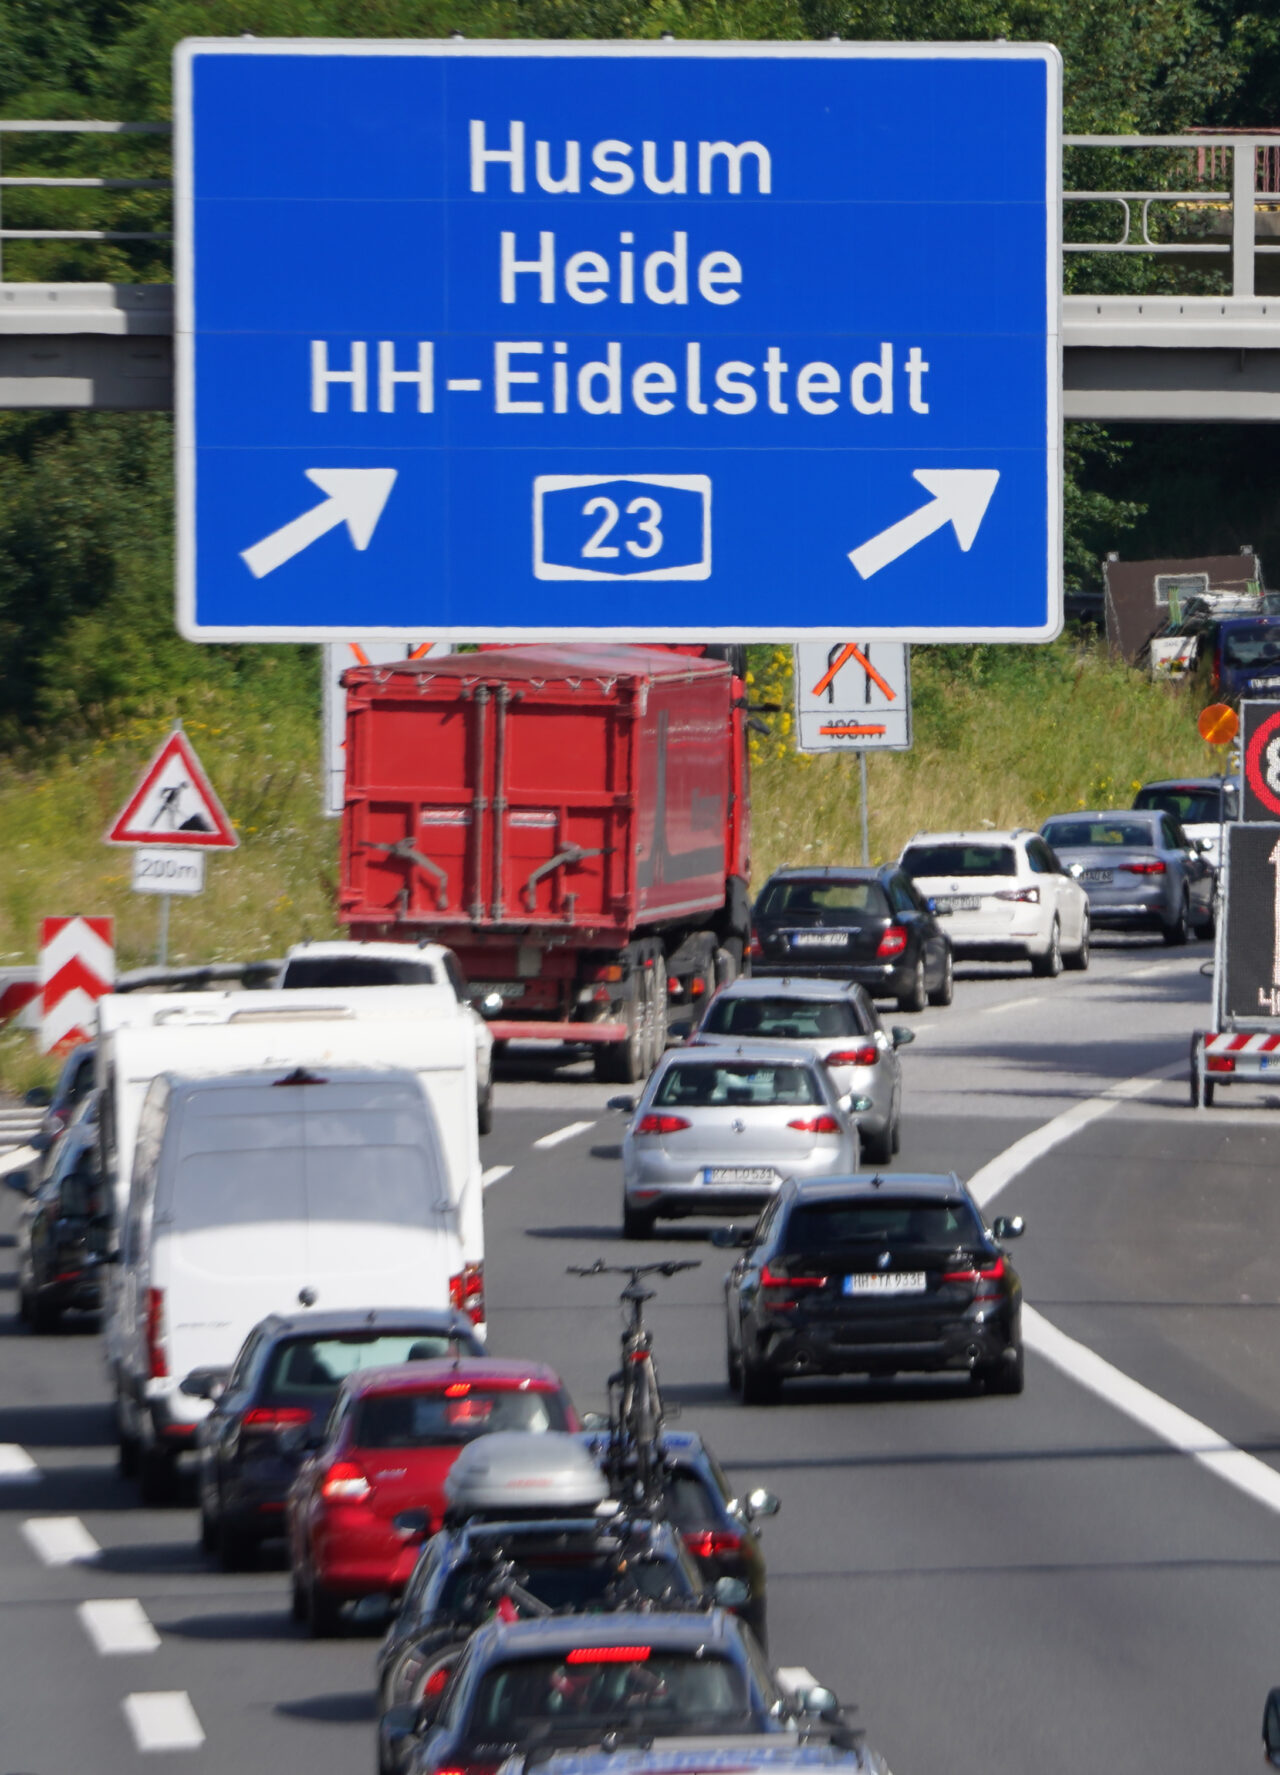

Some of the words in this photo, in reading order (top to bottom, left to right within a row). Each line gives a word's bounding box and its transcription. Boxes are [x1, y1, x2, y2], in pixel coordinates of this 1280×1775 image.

[470, 120, 771, 194] Husum
[500, 231, 742, 305] Heide
[311, 340, 930, 416] HH-Eidelstedt
[582, 496, 663, 558] 23
[136, 858, 198, 878] 200m
